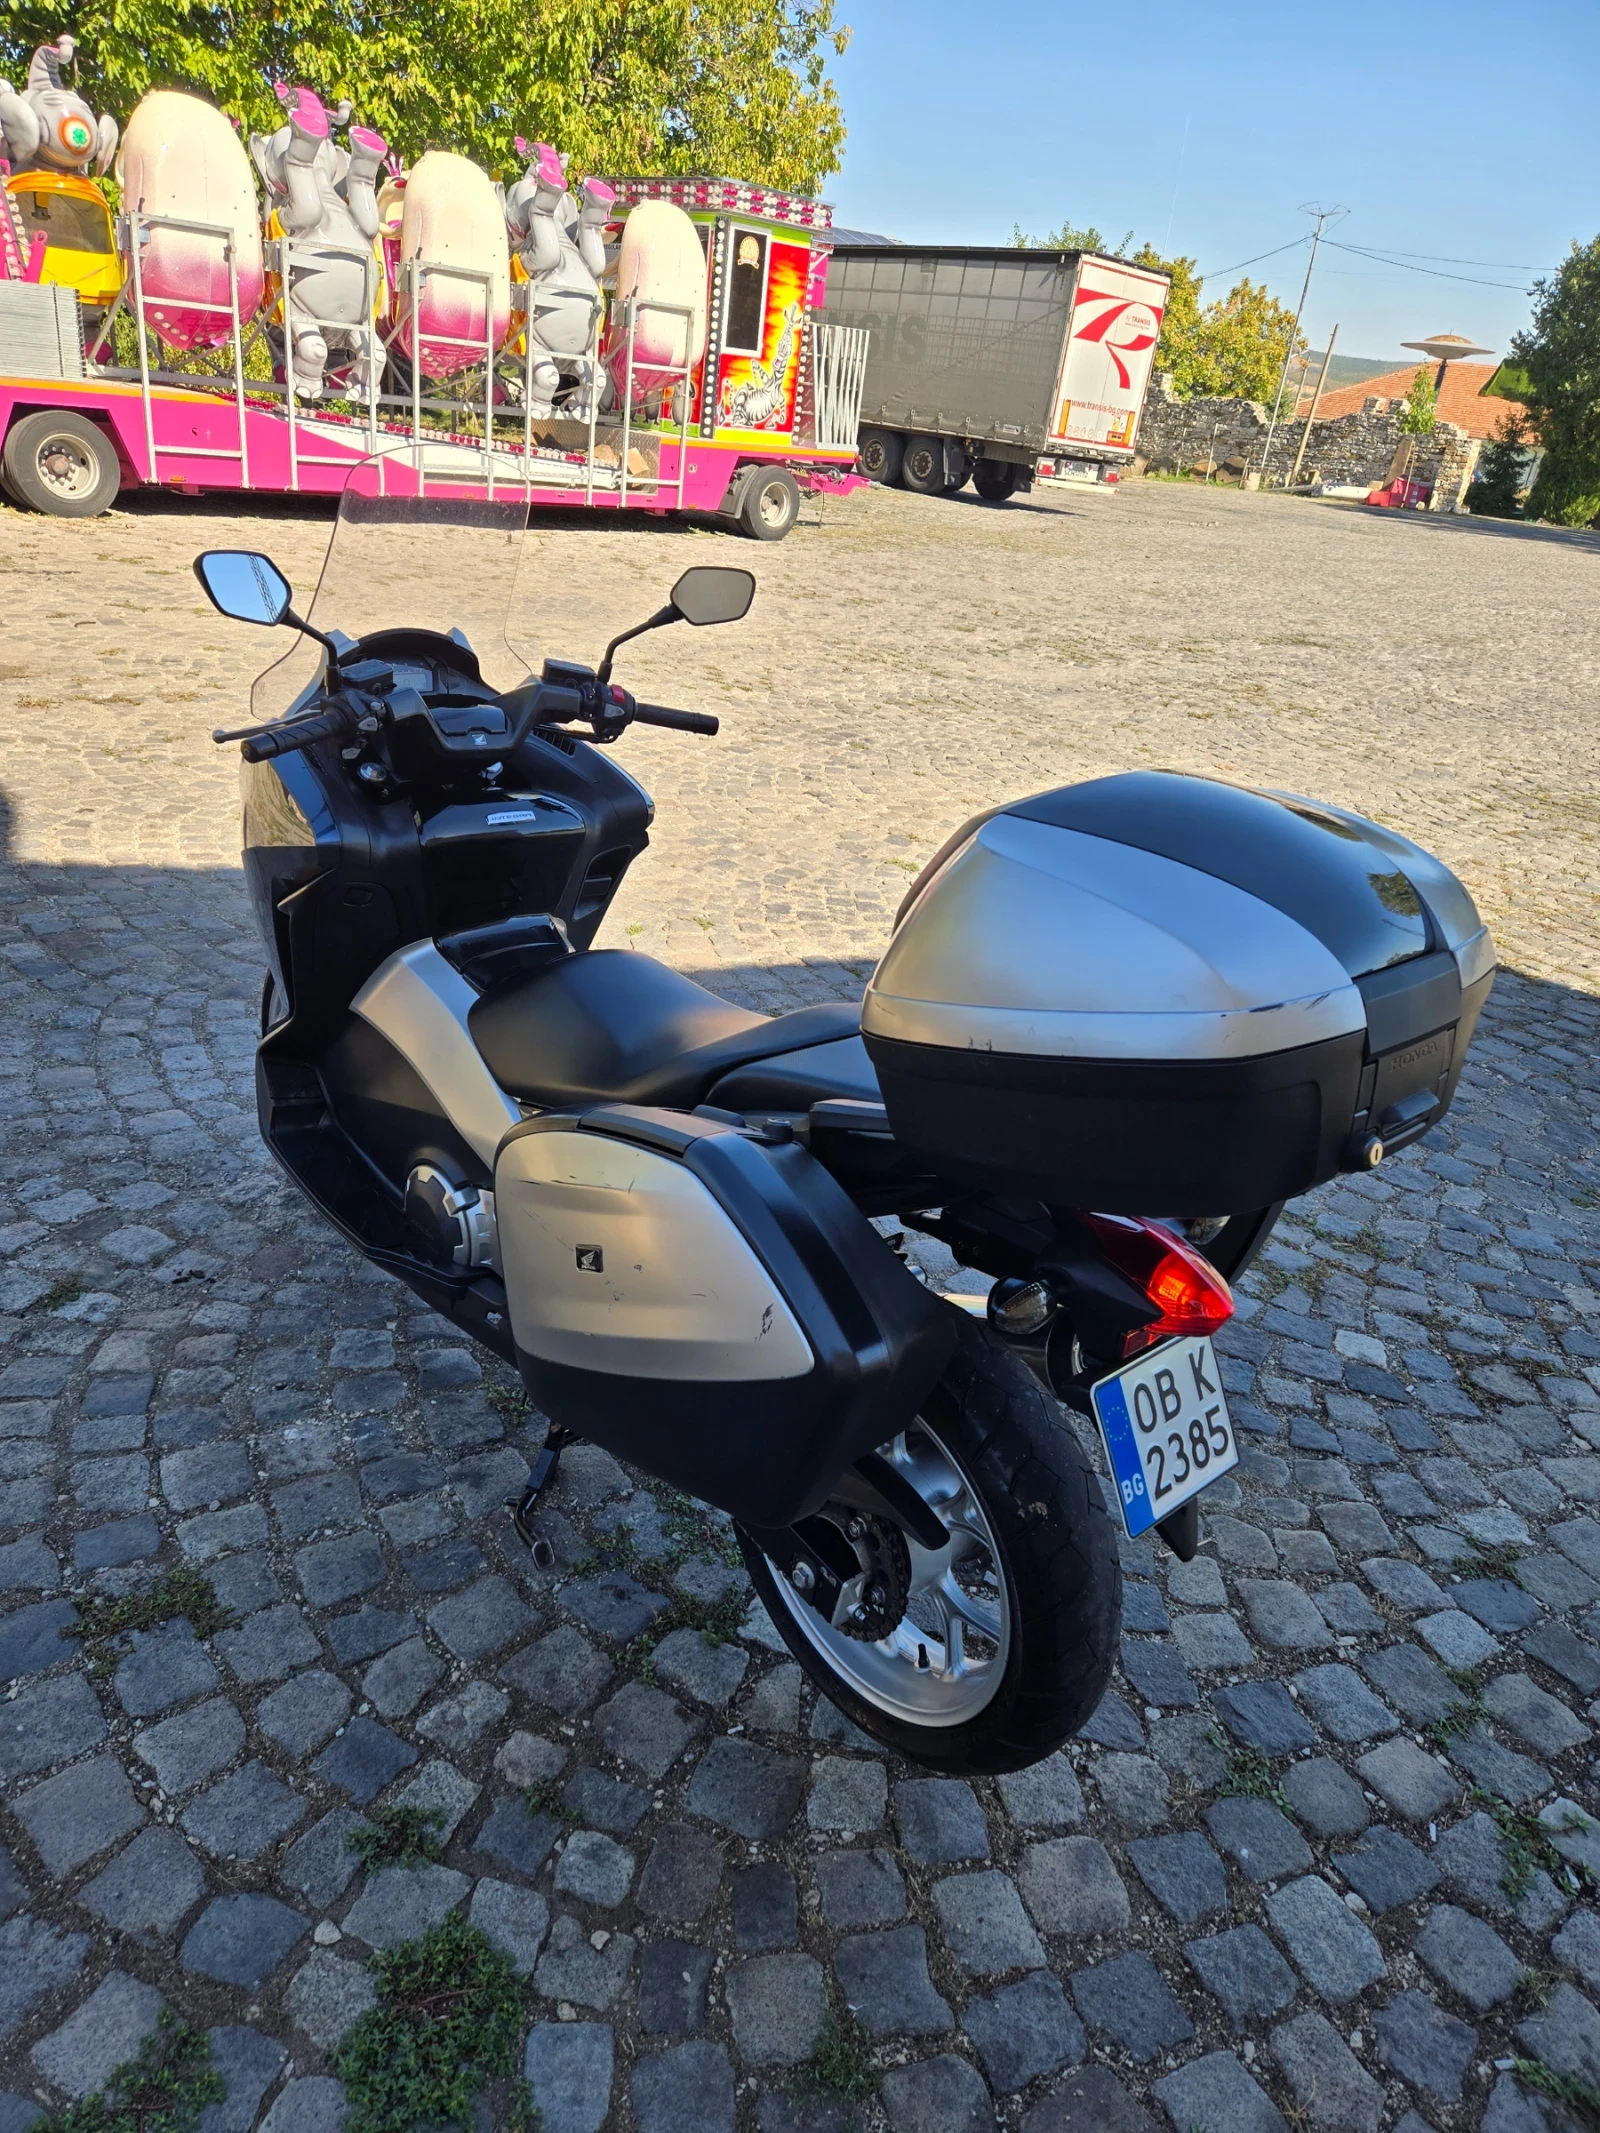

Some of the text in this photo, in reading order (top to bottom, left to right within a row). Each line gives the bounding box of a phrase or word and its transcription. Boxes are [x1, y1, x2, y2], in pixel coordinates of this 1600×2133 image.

[1071, 399, 1129, 416] www.transis-bg.com
[1388, 1041, 1438, 1073] HONDA
[1133, 1345, 1217, 1434] OB K
[1146, 1404, 1229, 1501] 2385
[1121, 1473, 1144, 1504] BG
